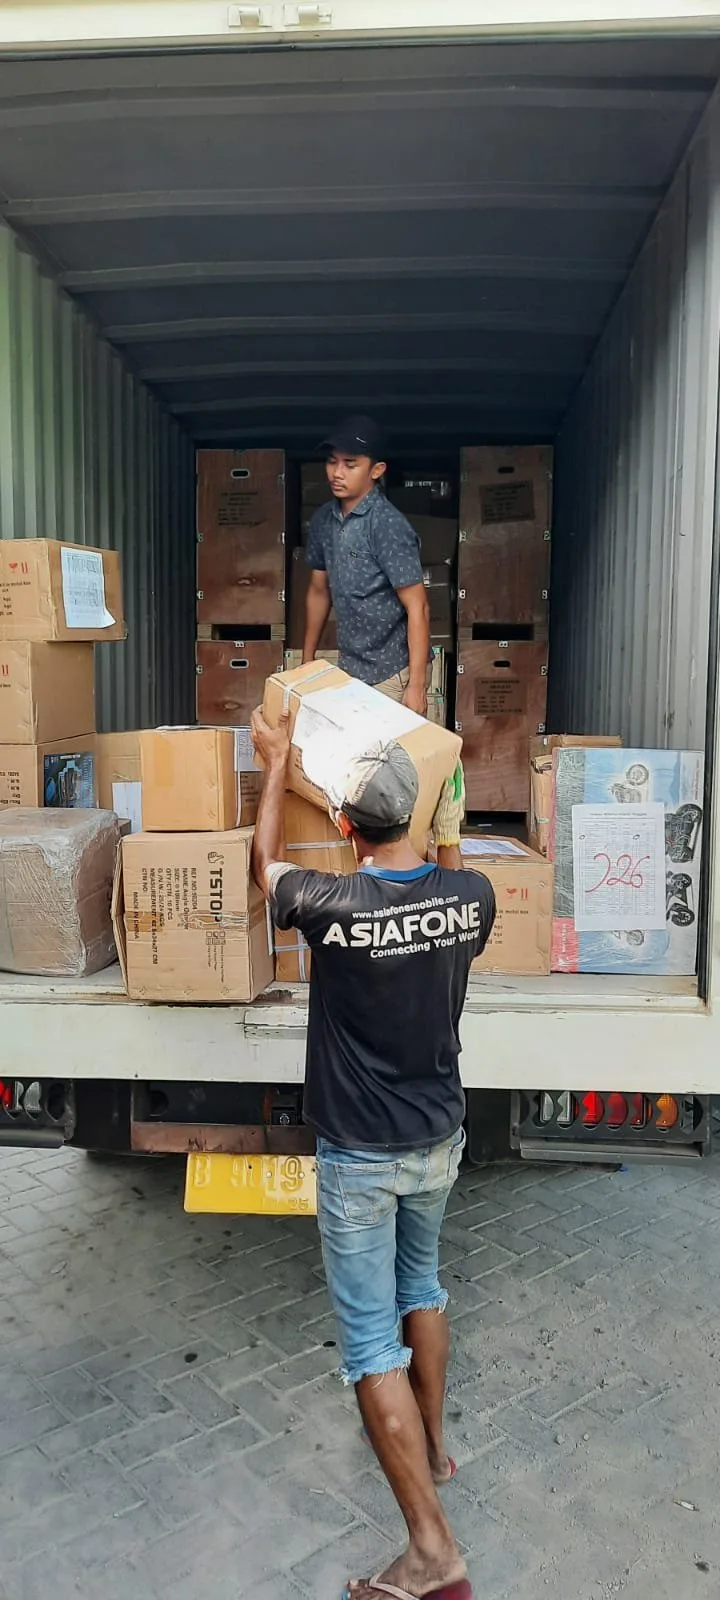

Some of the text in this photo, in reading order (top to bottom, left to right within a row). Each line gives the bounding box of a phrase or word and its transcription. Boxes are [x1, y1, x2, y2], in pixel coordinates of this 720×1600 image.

[352, 895, 459, 919] www.asiafonemobile.com
[322, 901, 481, 948] ASIAFONE
[370, 941, 431, 959] Connecting
[433, 936, 457, 949] Your
